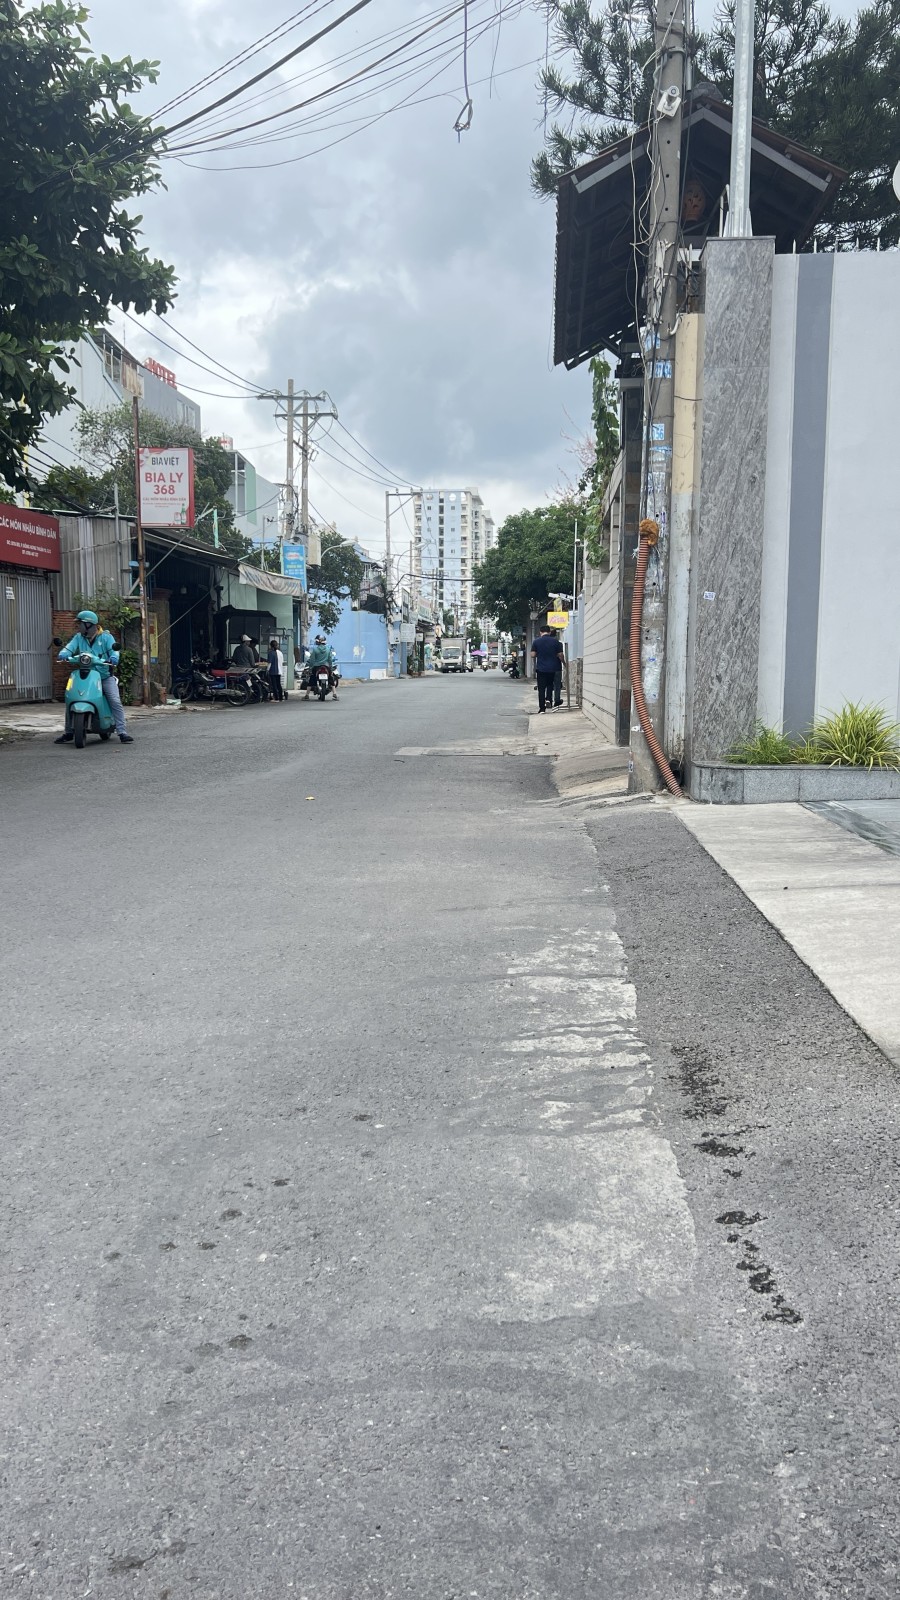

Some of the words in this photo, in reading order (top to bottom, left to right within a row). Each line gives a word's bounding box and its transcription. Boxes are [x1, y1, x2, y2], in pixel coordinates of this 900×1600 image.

[145, 472, 166, 483] BIA
[170, 472, 184, 483] LY
[153, 484, 175, 495] 368
